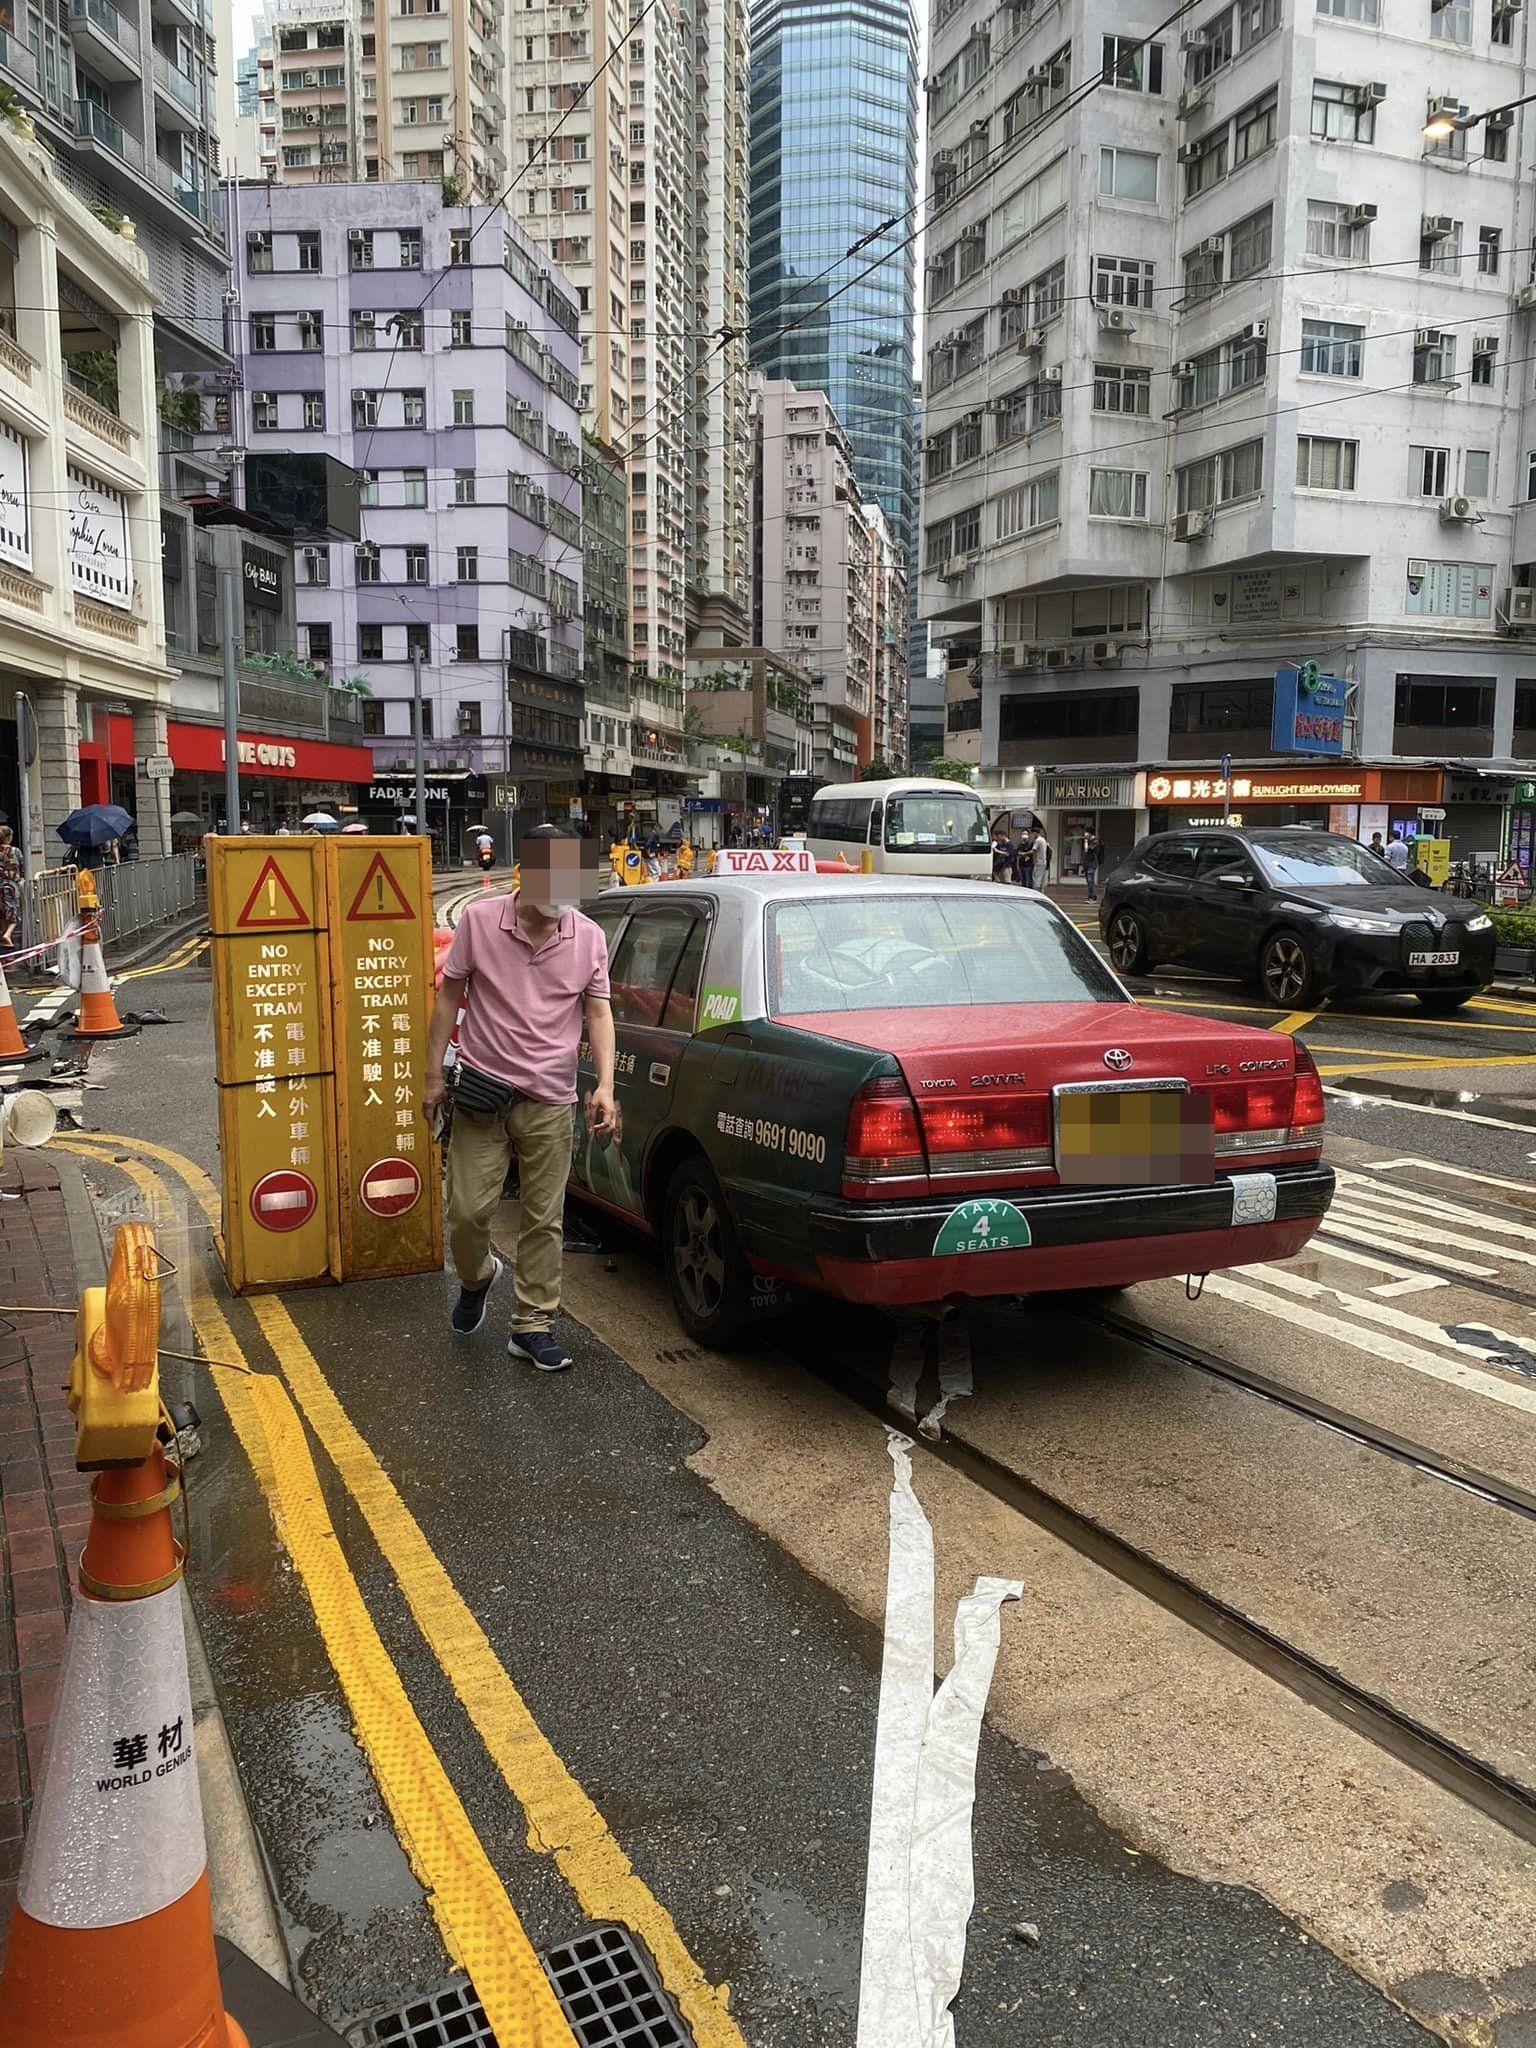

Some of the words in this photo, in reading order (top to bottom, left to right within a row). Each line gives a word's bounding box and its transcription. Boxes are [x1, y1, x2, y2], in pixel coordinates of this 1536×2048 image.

[259, 568, 278, 586] BAU
[221, 740, 256, 764] VE
[257, 743, 296, 767] GUYS
[369, 787, 404, 799] FADE
[1055, 786, 1111, 799] MARINO
[1252, 785, 1300, 795] SUNLIGHT
[1299, 784, 1362, 794] EMPLOYMENT
[727, 851, 809, 872] TAXI
[261, 944, 288, 959] NO
[368, 938, 395, 951] NO
[356, 956, 408, 971] ENTRY
[1411, 954, 1426, 964] HA
[1431, 953, 1457, 963] 2833
[248, 963, 302, 978] ENTRY
[354, 974, 413, 989] EXCEPT
[246, 982, 307, 998] EXCEPT
[252, 1001, 303, 1016] TRAM
[360, 993, 408, 1008] TRAM
[703, 993, 738, 1021] POAD
[361, 1014, 383, 1106] 不准駛入
[1206, 1064, 1231, 1075] LPG
[1239, 1059, 1289, 1072] COMFORT
[253, 1023, 277, 1119] 不准駛入
[391, 1012, 415, 1152] 電車以外車輛
[919, 1078, 957, 1089] TOYOTA
[716, 1111, 754, 1141] 電話查詢
[755, 1119, 787, 1152] 9691
[788, 1128, 826, 1164] 9090
[958, 1201, 1008, 1219] TAXI
[972, 1215, 991, 1237] 4
[956, 1236, 1009, 1251] SEATS
[750, 1292, 792, 1308] TOYOA
[112, 1715, 183, 1771] 華材
[96, 1770, 152, 1793] WORLD
[156, 1745, 192, 1777] GENIUS
